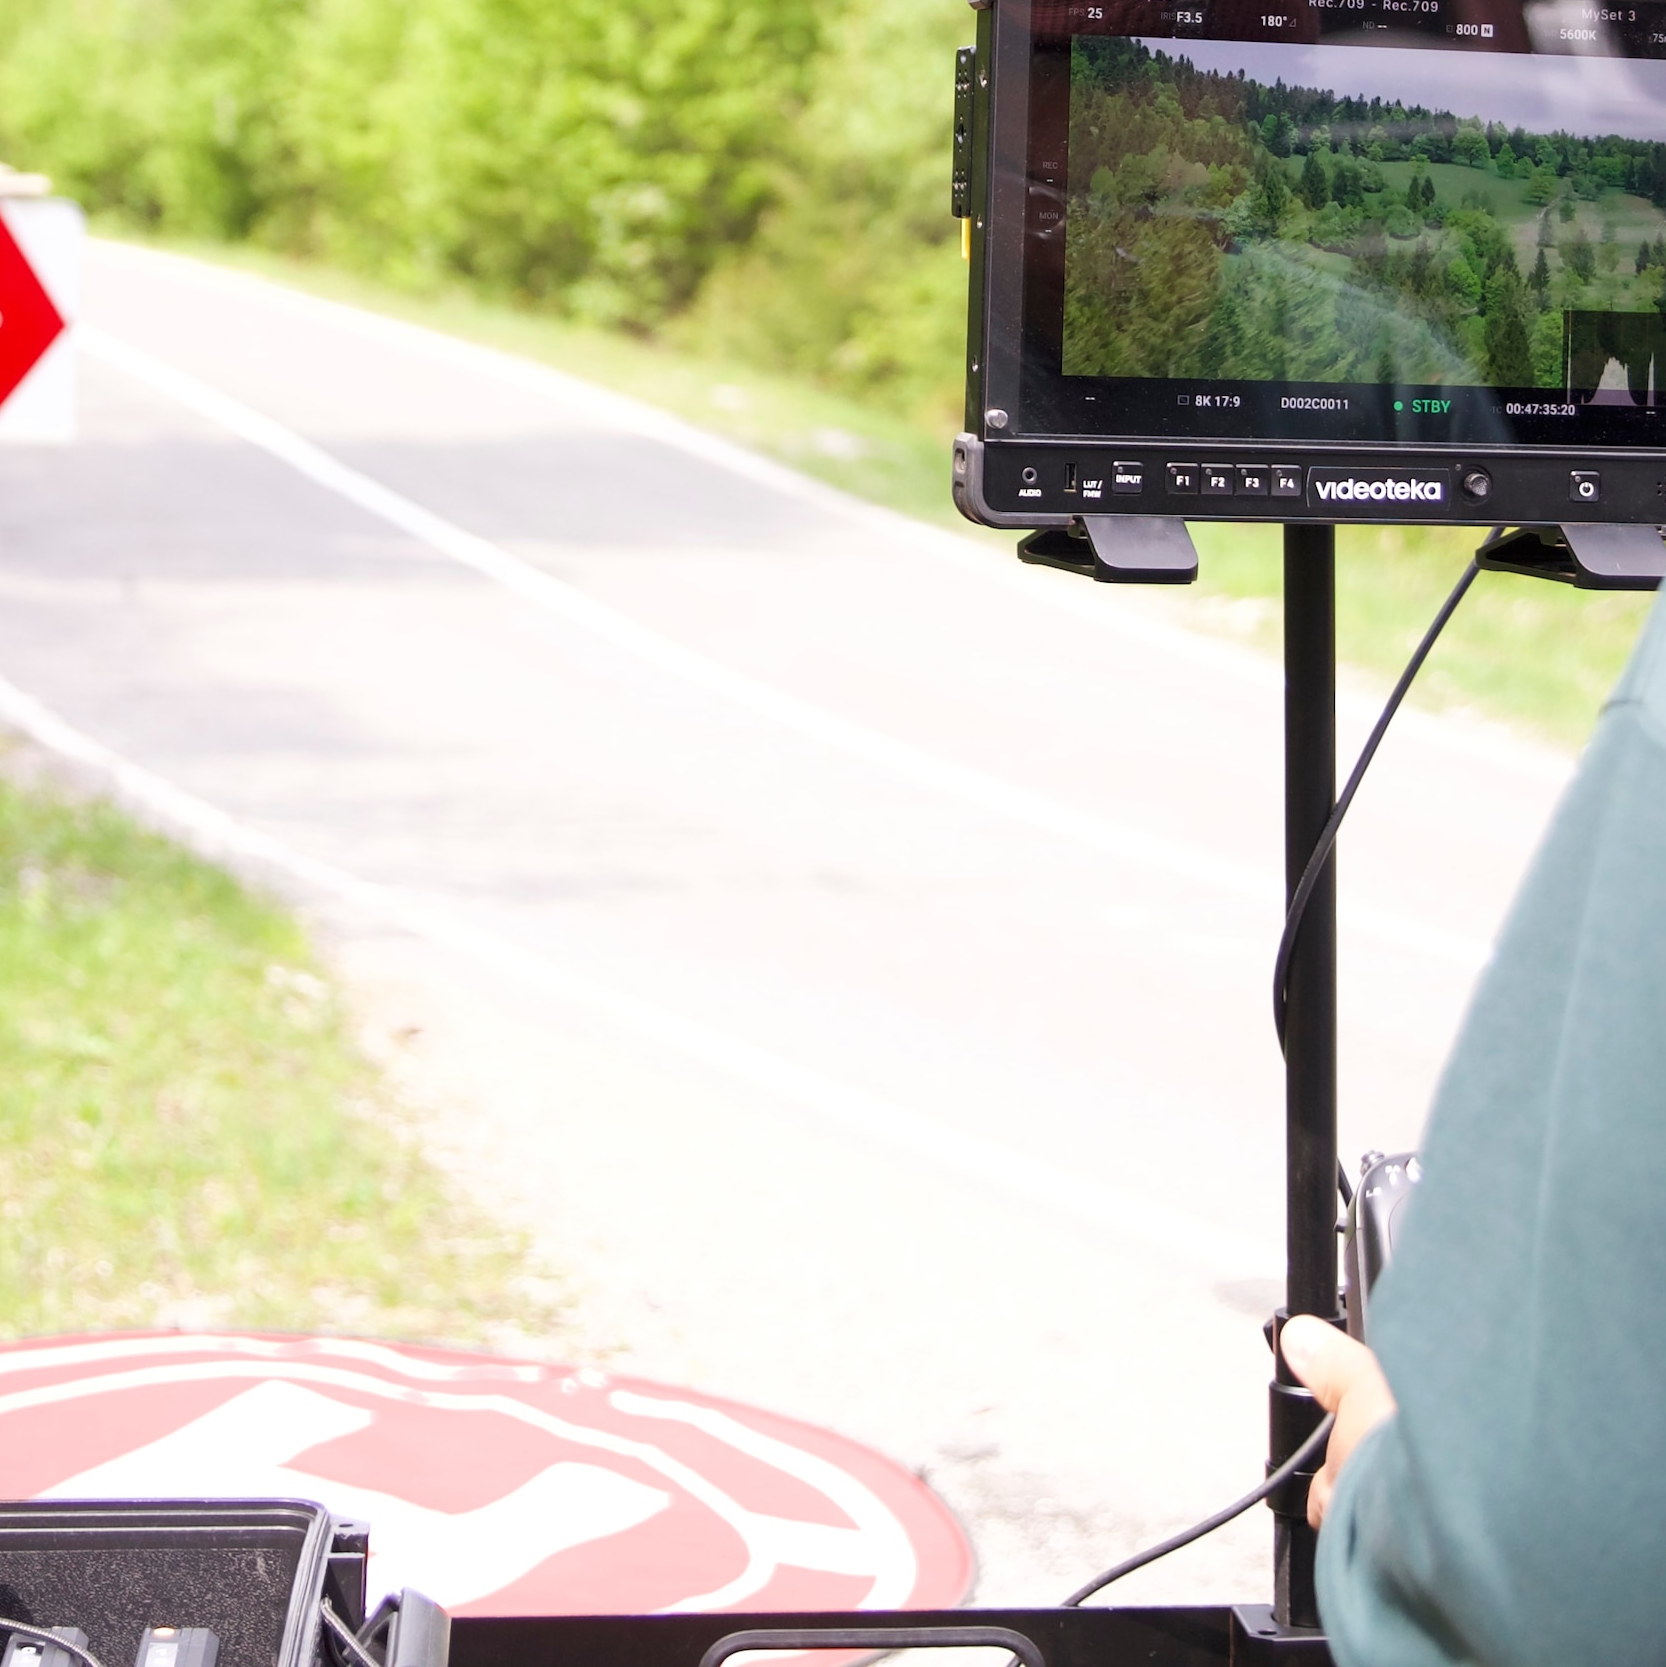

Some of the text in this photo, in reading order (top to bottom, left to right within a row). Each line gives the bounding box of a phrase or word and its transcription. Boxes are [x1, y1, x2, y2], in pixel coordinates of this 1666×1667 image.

[1383, 0, 1439, 12] Rec.709
[1068, 7, 1103, 19] FPS 25
[1581, 9, 1636, 22] MySet 3
[1362, 21, 1375, 30] ND
[1456, 23, 1478, 36] 800
[1559, 28, 1597, 41] 5600K
[1042, 161, 1058, 170] REC
[1039, 212, 1059, 220] MON
[1195, 395, 1241, 408] 8K 17:9
[1281, 397, 1349, 410] D002C0011
[1412, 399, 1451, 413] STBY
[1506, 403, 1575, 416] 00:47:35:20
[1116, 475, 1142, 484] INPUT
[1176, 476, 1189, 486] F1
[1211, 477, 1225, 487] F2
[1245, 478, 1259, 488] F3
[1279, 478, 1294, 489] F4
[1018, 488, 1042, 497] AUDIO
[1315, 478, 1441, 501] videoteka
